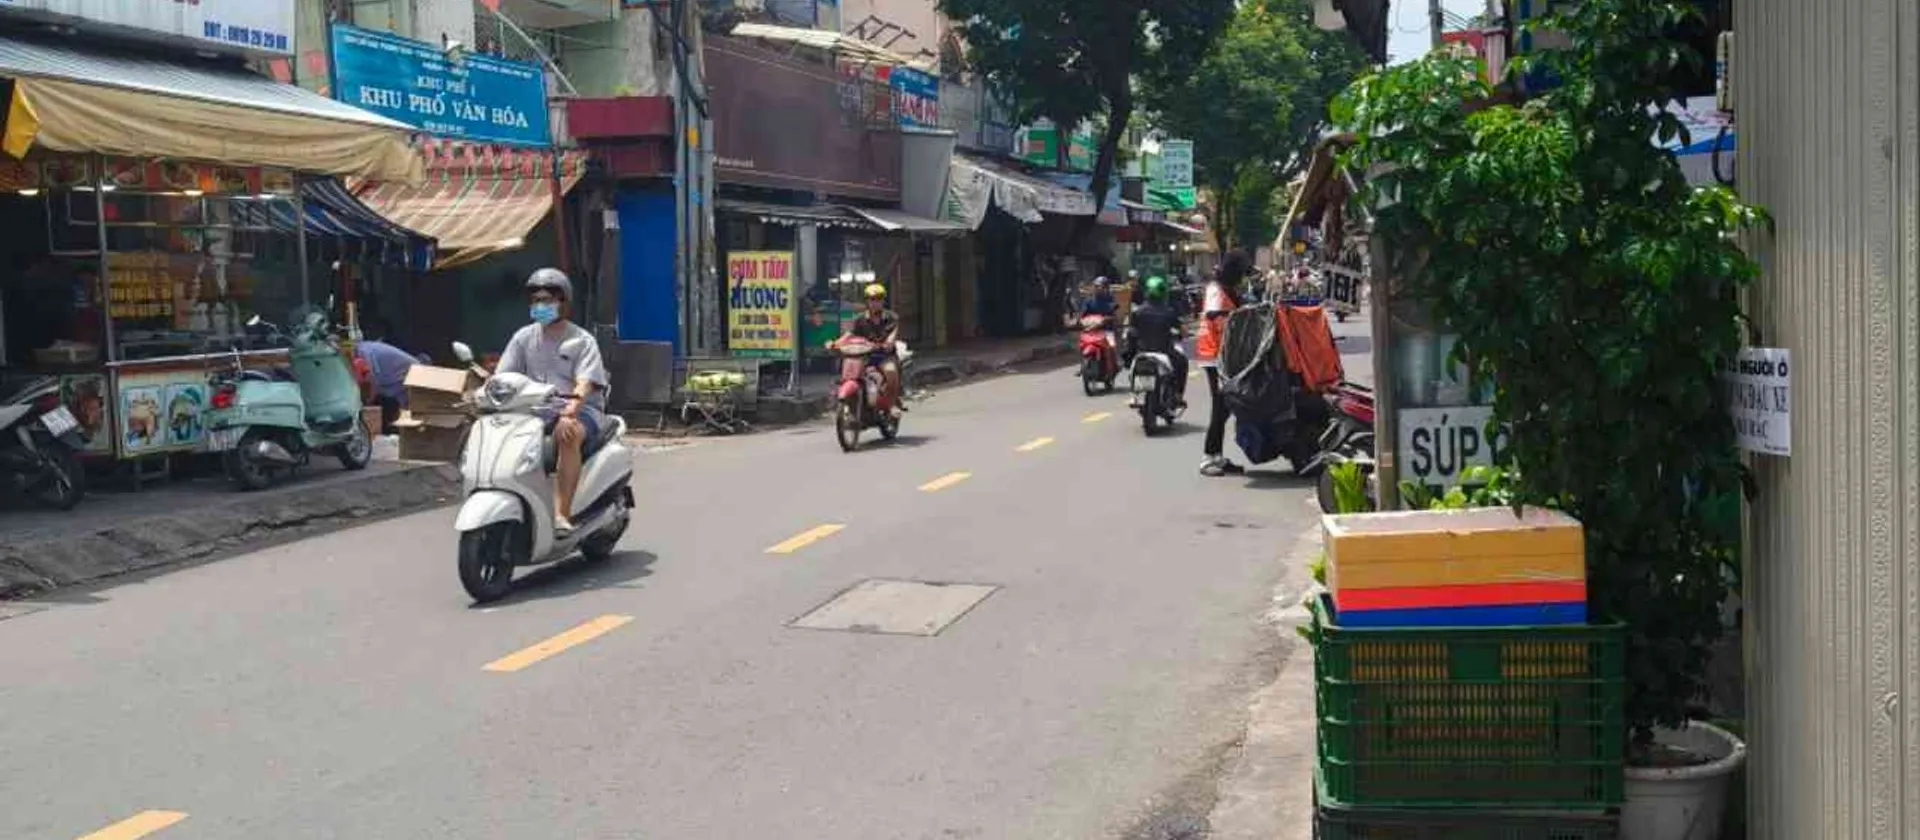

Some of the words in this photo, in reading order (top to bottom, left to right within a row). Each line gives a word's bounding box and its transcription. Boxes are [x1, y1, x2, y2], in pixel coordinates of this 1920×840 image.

[360, 85, 403, 110] KHU
[408, 91, 446, 116] PHỐ
[451, 98, 488, 122] VĂN
[491, 105, 530, 129] HÓA
[1411, 413, 1479, 477] SÚP
